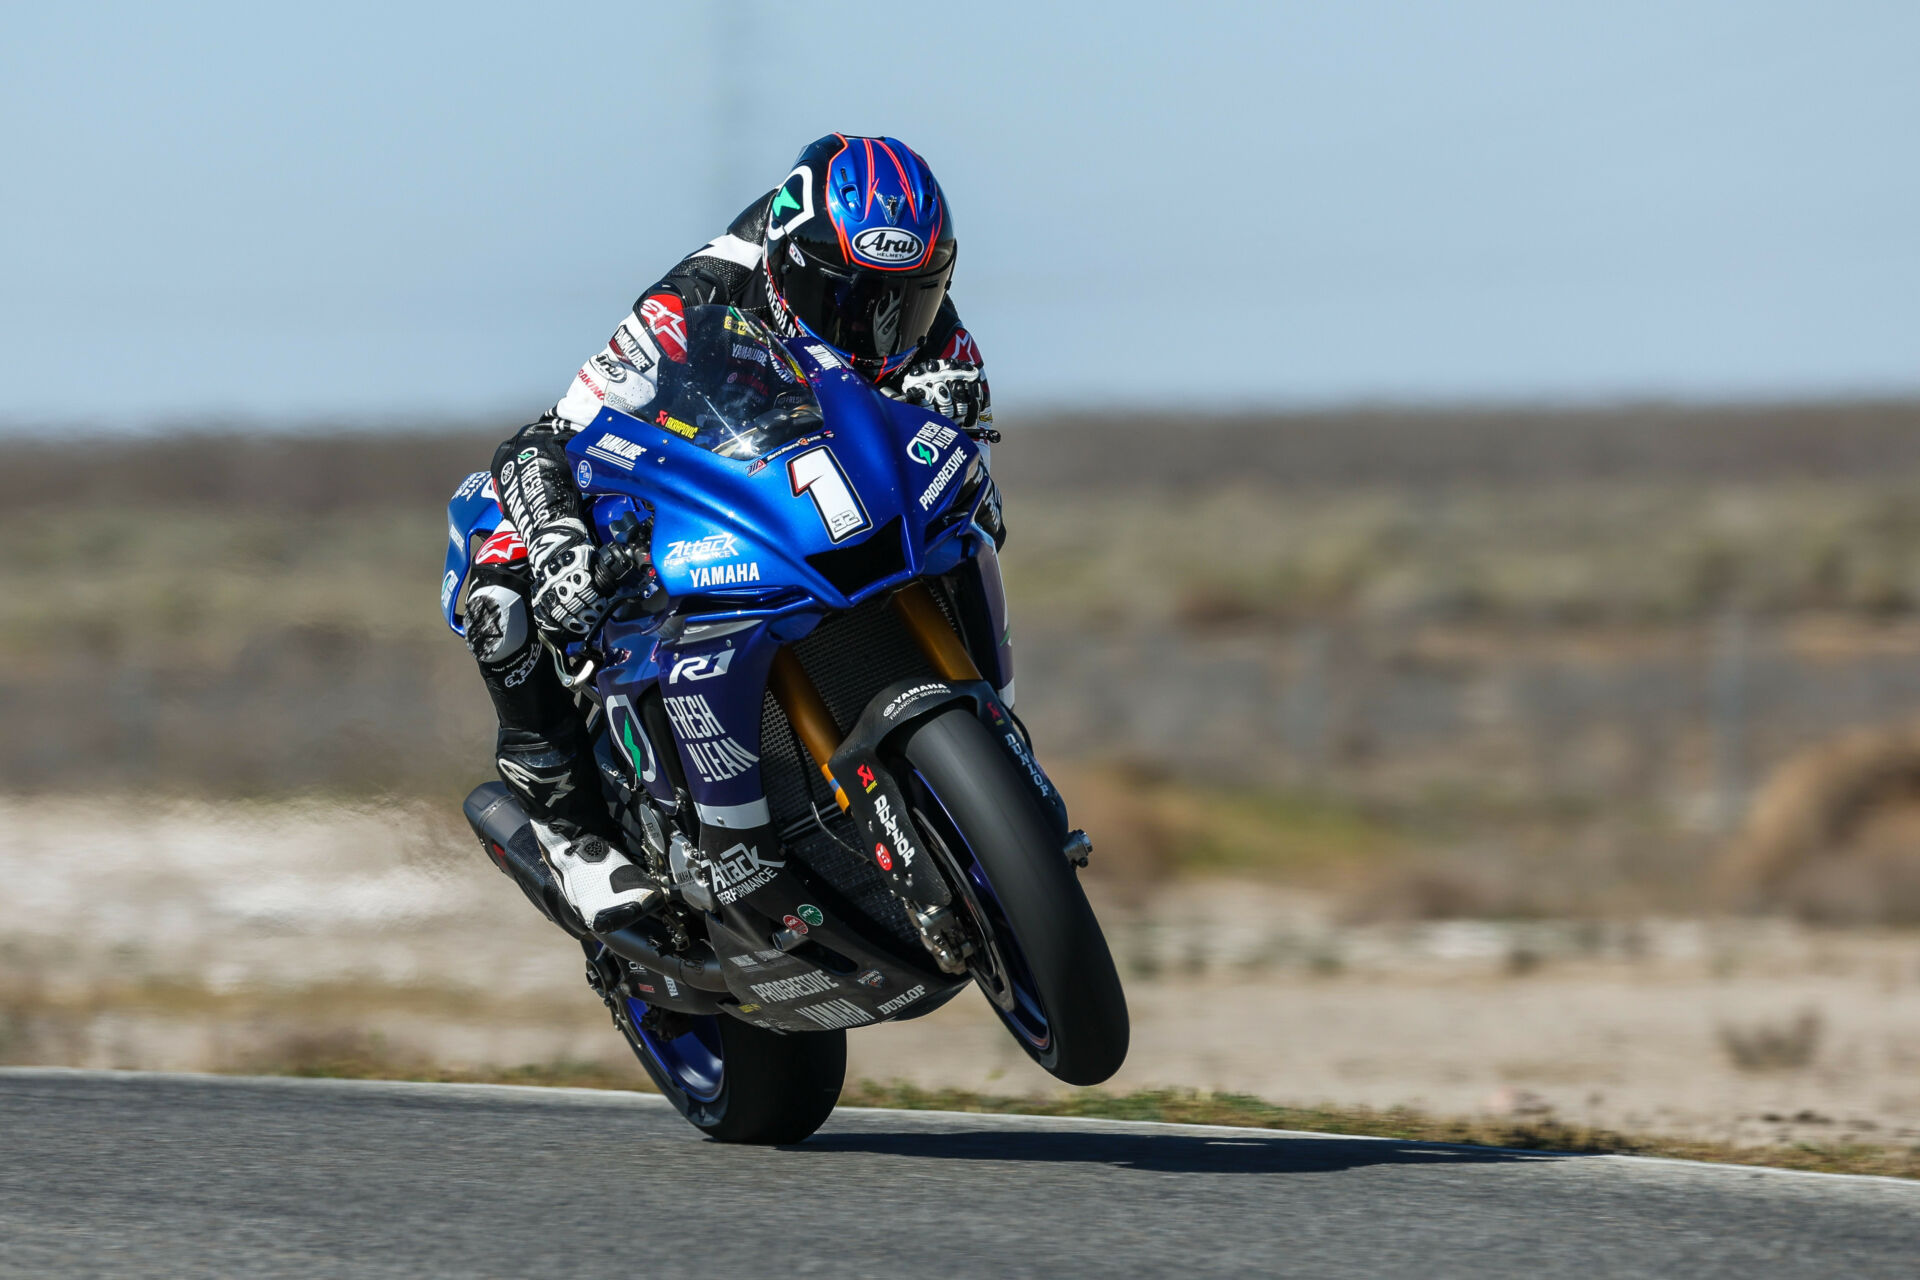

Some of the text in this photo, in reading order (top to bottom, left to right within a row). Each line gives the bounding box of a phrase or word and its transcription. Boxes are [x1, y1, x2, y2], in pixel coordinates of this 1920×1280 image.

[859, 232, 916, 254] Arai
[786, 446, 872, 544] 1
[918, 446, 968, 512] PROGRESSIVE
[690, 562, 760, 588] YAMAHA
[893, 683, 947, 704] YAMAHA
[663, 694, 726, 740] FRESH
[1005, 732, 1048, 797] DUNLOP
[874, 794, 915, 868] DUNLOP
[701, 842, 787, 893] Attack
[716, 866, 778, 906] PERFORMANCE
[750, 968, 839, 1004] PROGRESSIVE
[877, 984, 926, 1015] DUNLOP
[795, 997, 876, 1031] YAMAHA
